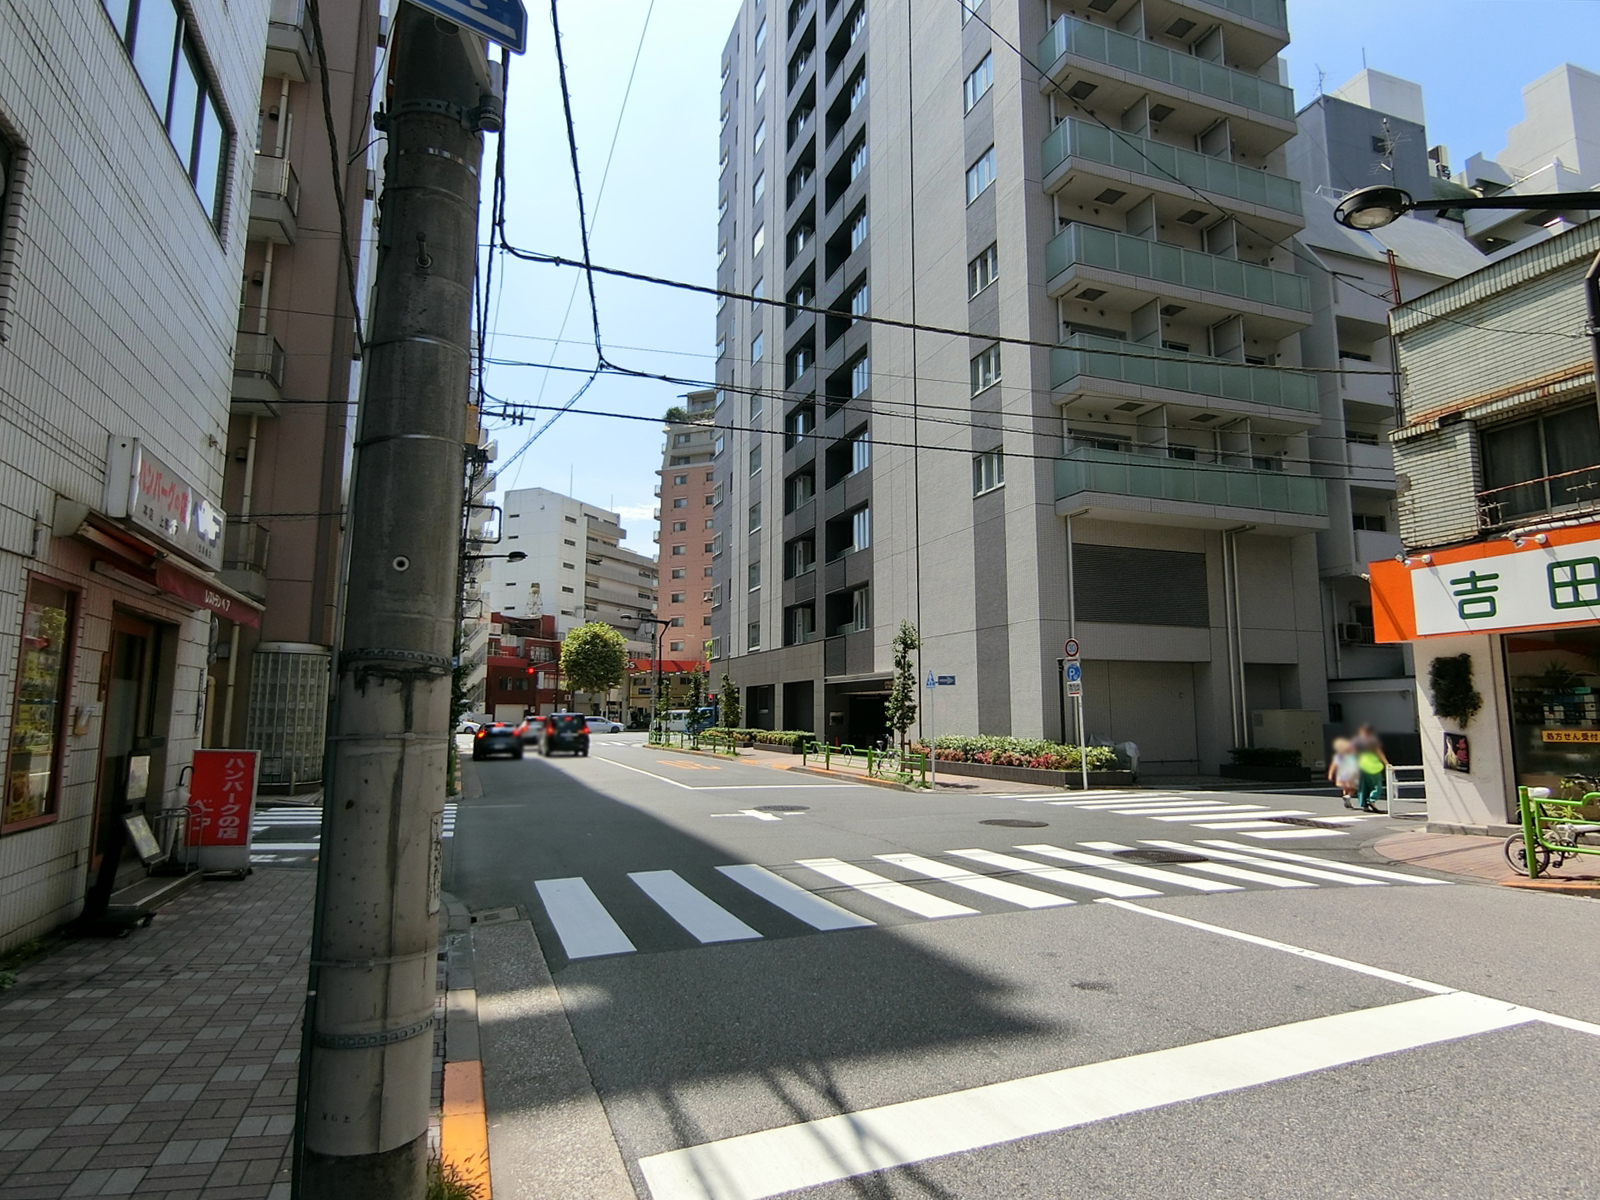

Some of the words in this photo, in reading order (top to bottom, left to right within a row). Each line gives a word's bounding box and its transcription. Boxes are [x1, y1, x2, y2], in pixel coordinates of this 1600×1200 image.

[1449, 556, 1600, 620] 吉田
[1067, 643, 1076, 653] 30
[1546, 732, 1598, 741] 処方せん受付
[217, 758, 245, 839] ハンバーグの店
